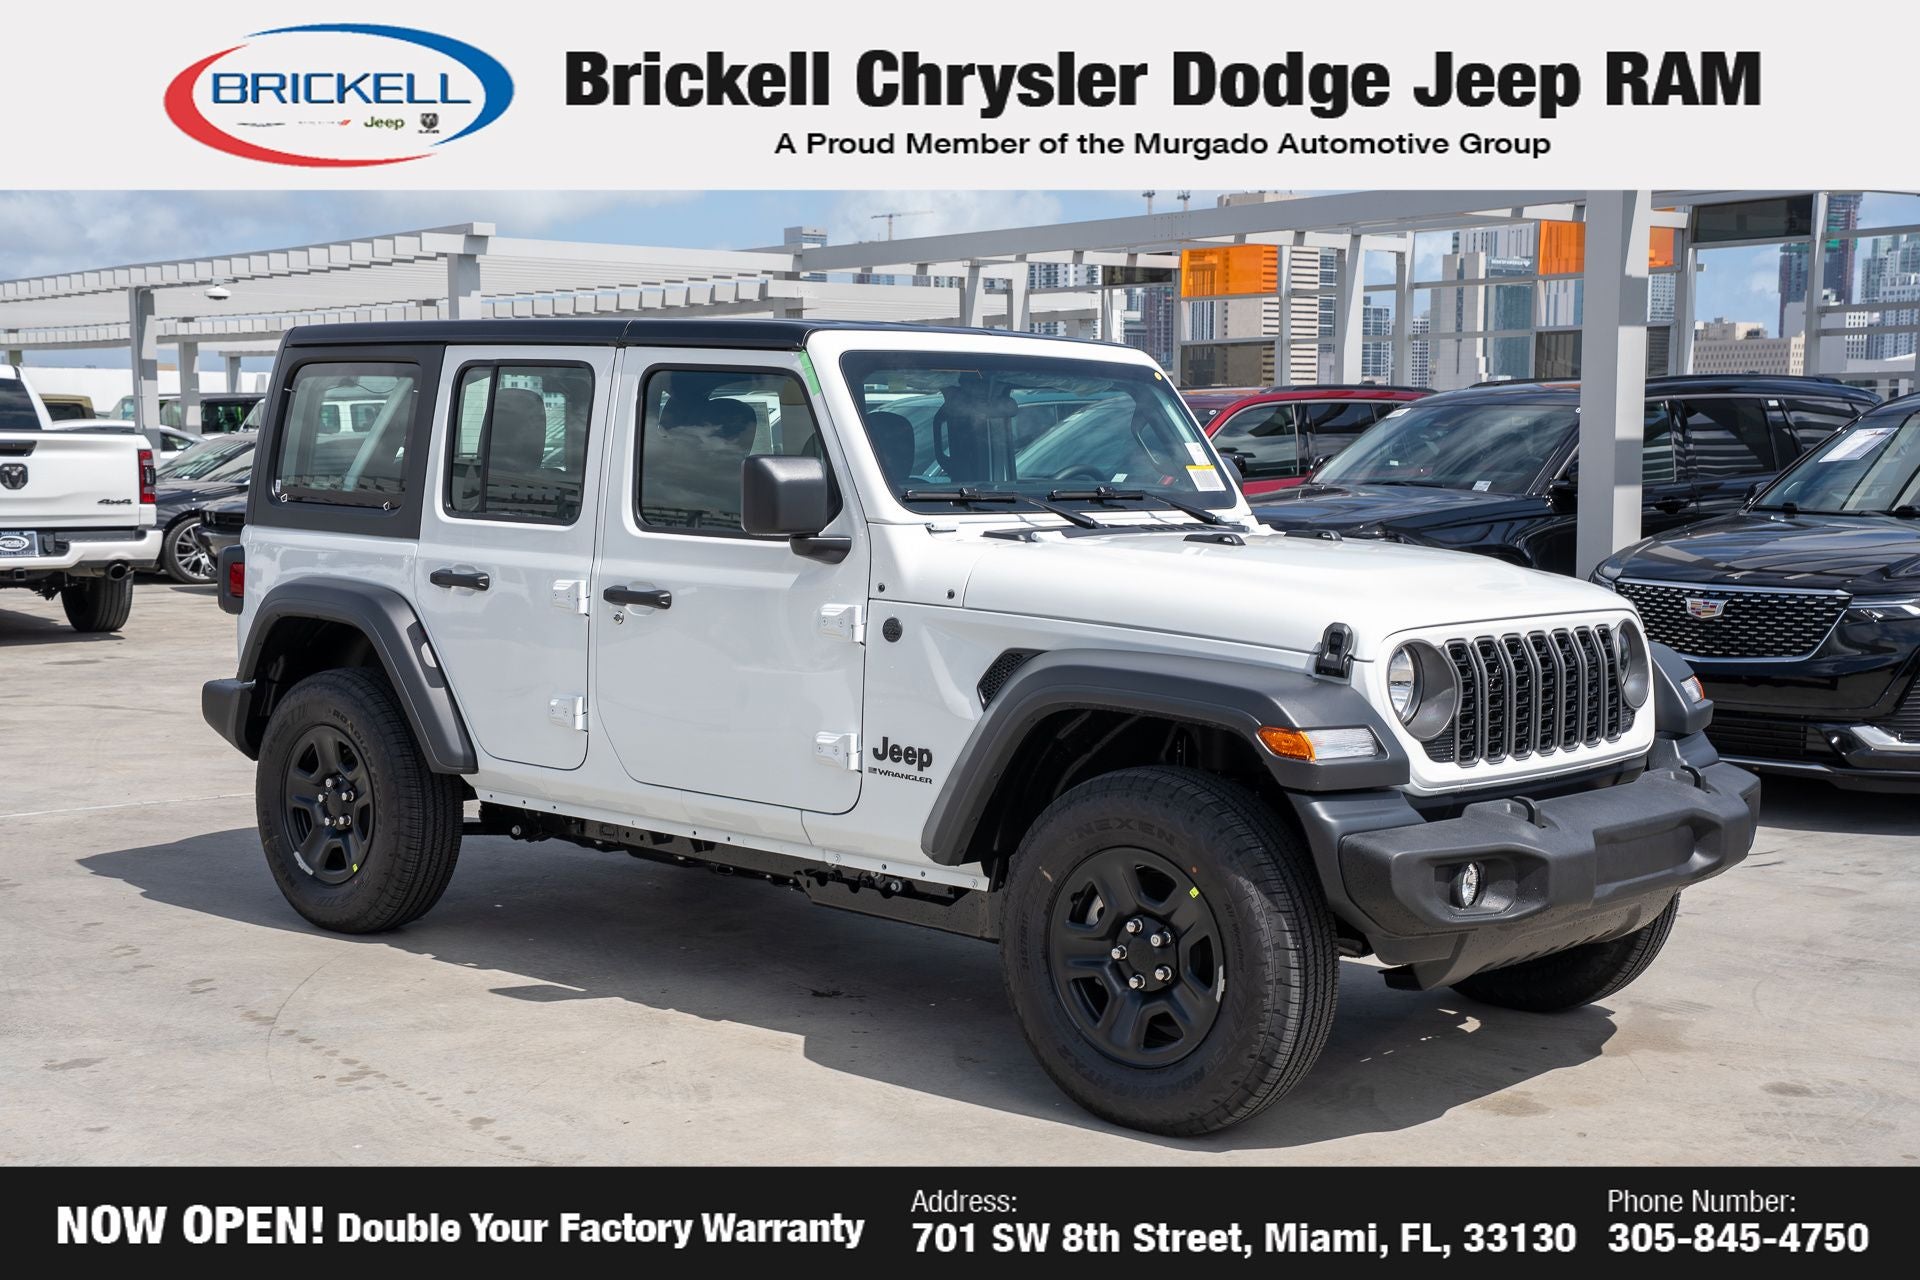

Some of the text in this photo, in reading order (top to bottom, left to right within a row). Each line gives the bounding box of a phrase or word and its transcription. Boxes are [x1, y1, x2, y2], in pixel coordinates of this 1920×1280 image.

[872, 736, 933, 772] Jeep
[878, 768, 933, 784] WRANGLER
[1075, 816, 1176, 847] NEXEN
